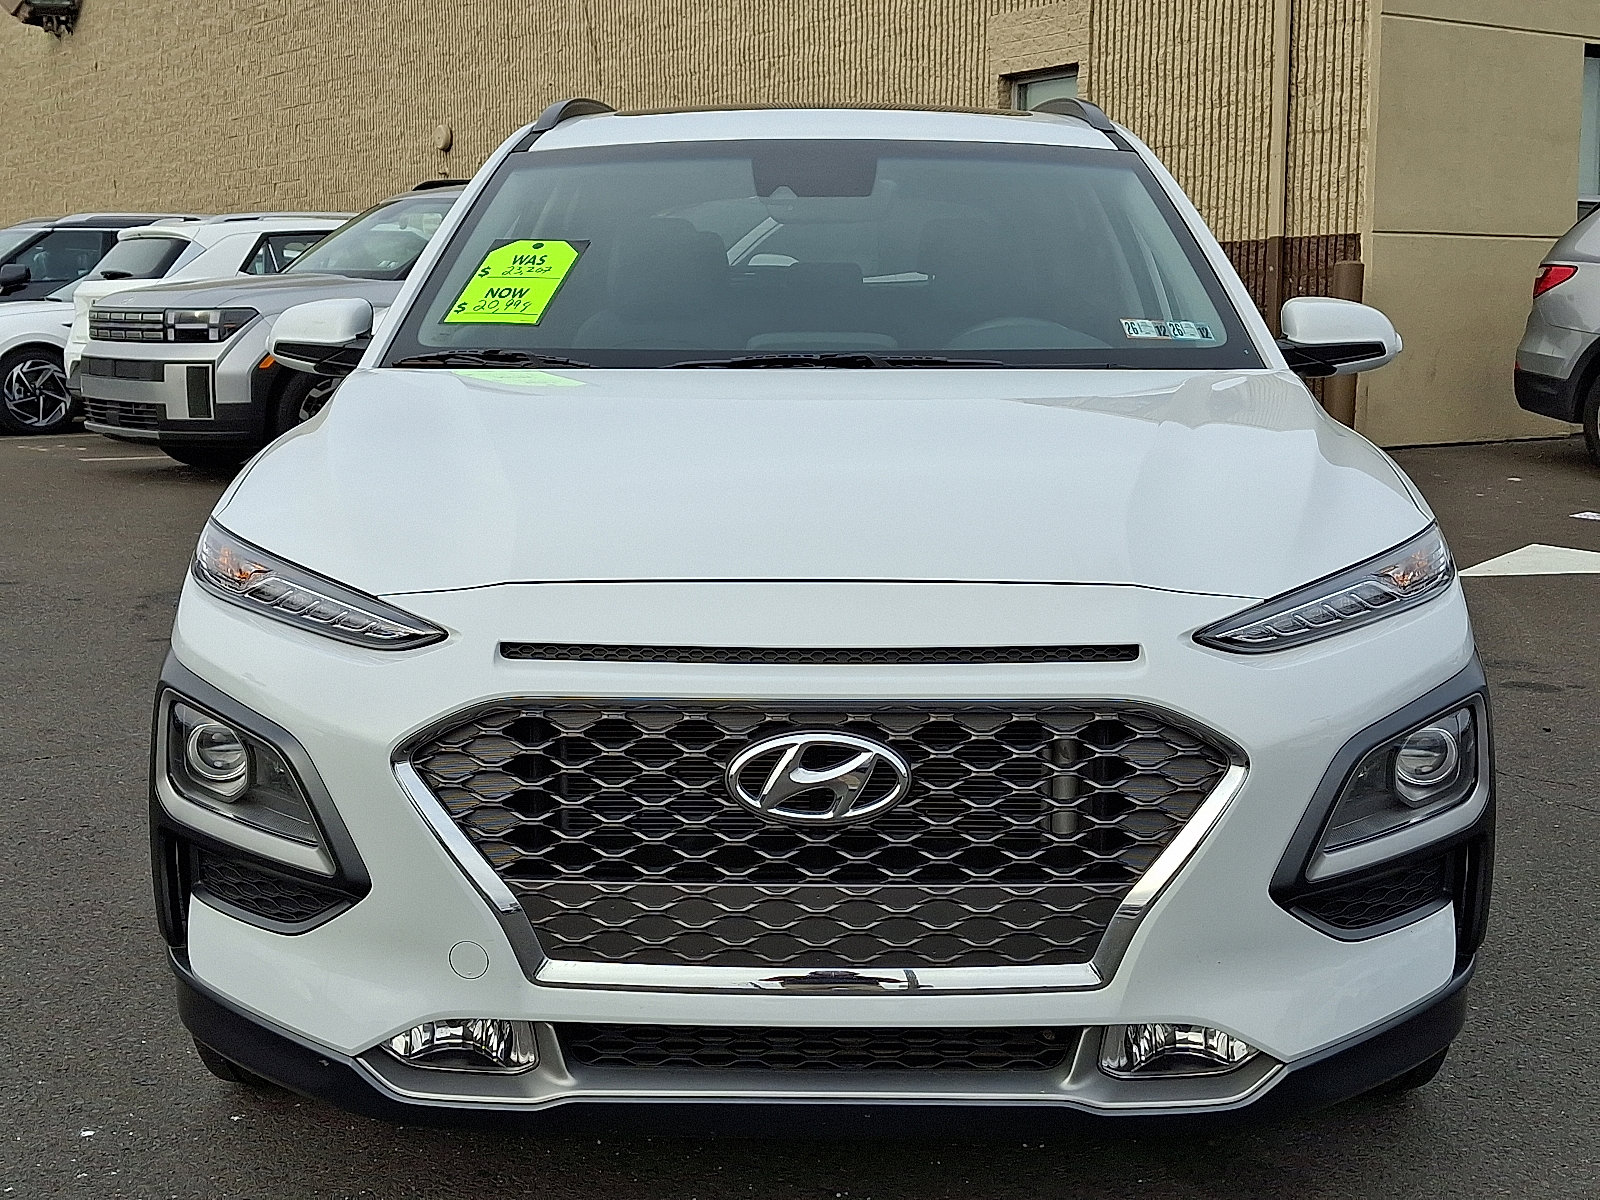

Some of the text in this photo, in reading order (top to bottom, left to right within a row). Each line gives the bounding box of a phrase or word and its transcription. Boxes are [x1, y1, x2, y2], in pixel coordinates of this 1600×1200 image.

[512, 254, 548, 266] WAS
[478, 266, 491, 278] $
[484, 287, 530, 299] NOW
[453, 301, 468, 314] $
[1124, 321, 1139, 335] 26
[1154, 325, 1170, 337] 12
[1168, 322, 1184, 337] 26
[1197, 326, 1213, 339] 12
